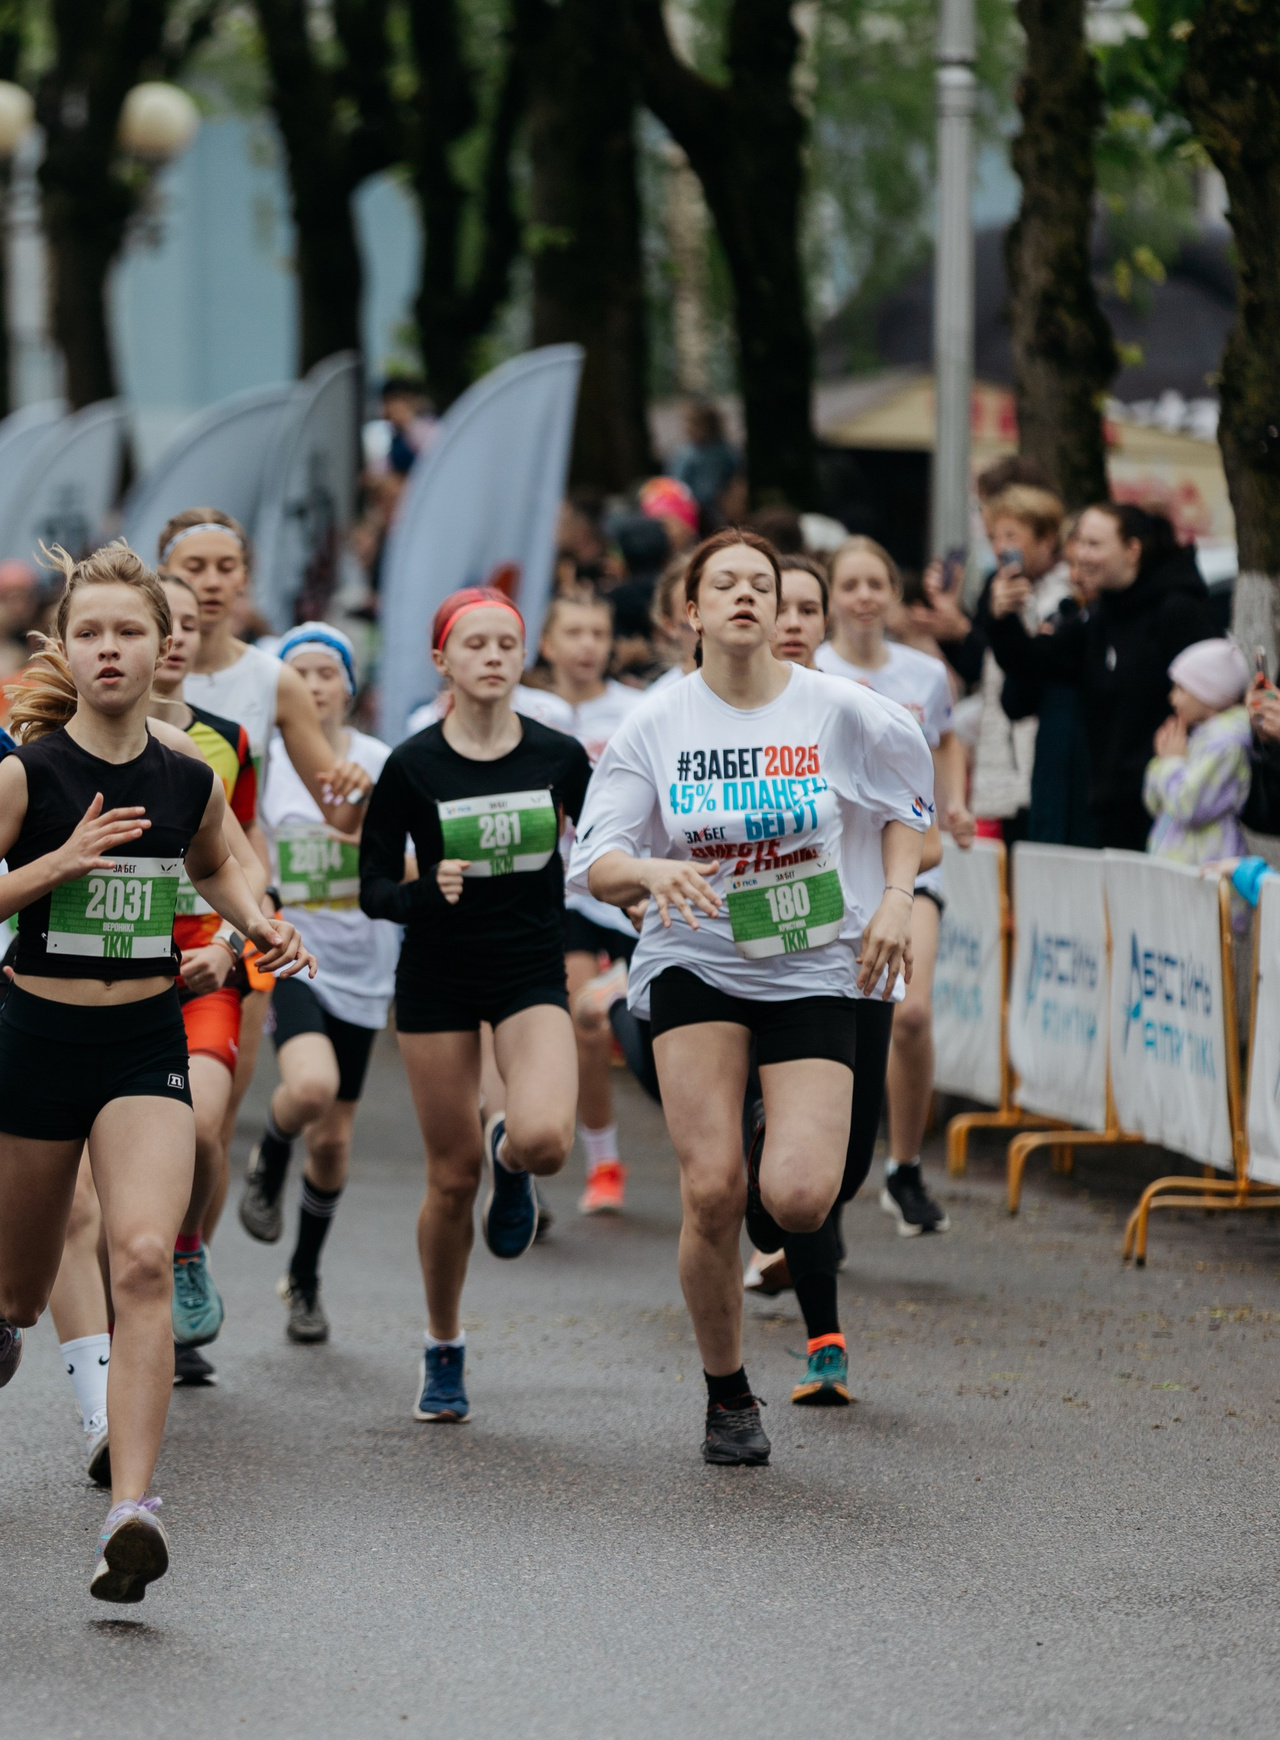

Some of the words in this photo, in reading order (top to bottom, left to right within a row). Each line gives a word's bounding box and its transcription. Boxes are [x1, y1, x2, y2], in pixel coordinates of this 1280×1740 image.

[677, 745, 820, 781] #ЗАБЕГ2025
[479, 811, 521, 849] 281
[745, 799, 818, 841] БЕГУТ
[85, 878, 153, 921] 2031
[765, 881, 811, 922] 180
[102, 922, 134, 933] ВЕРОНИКА
